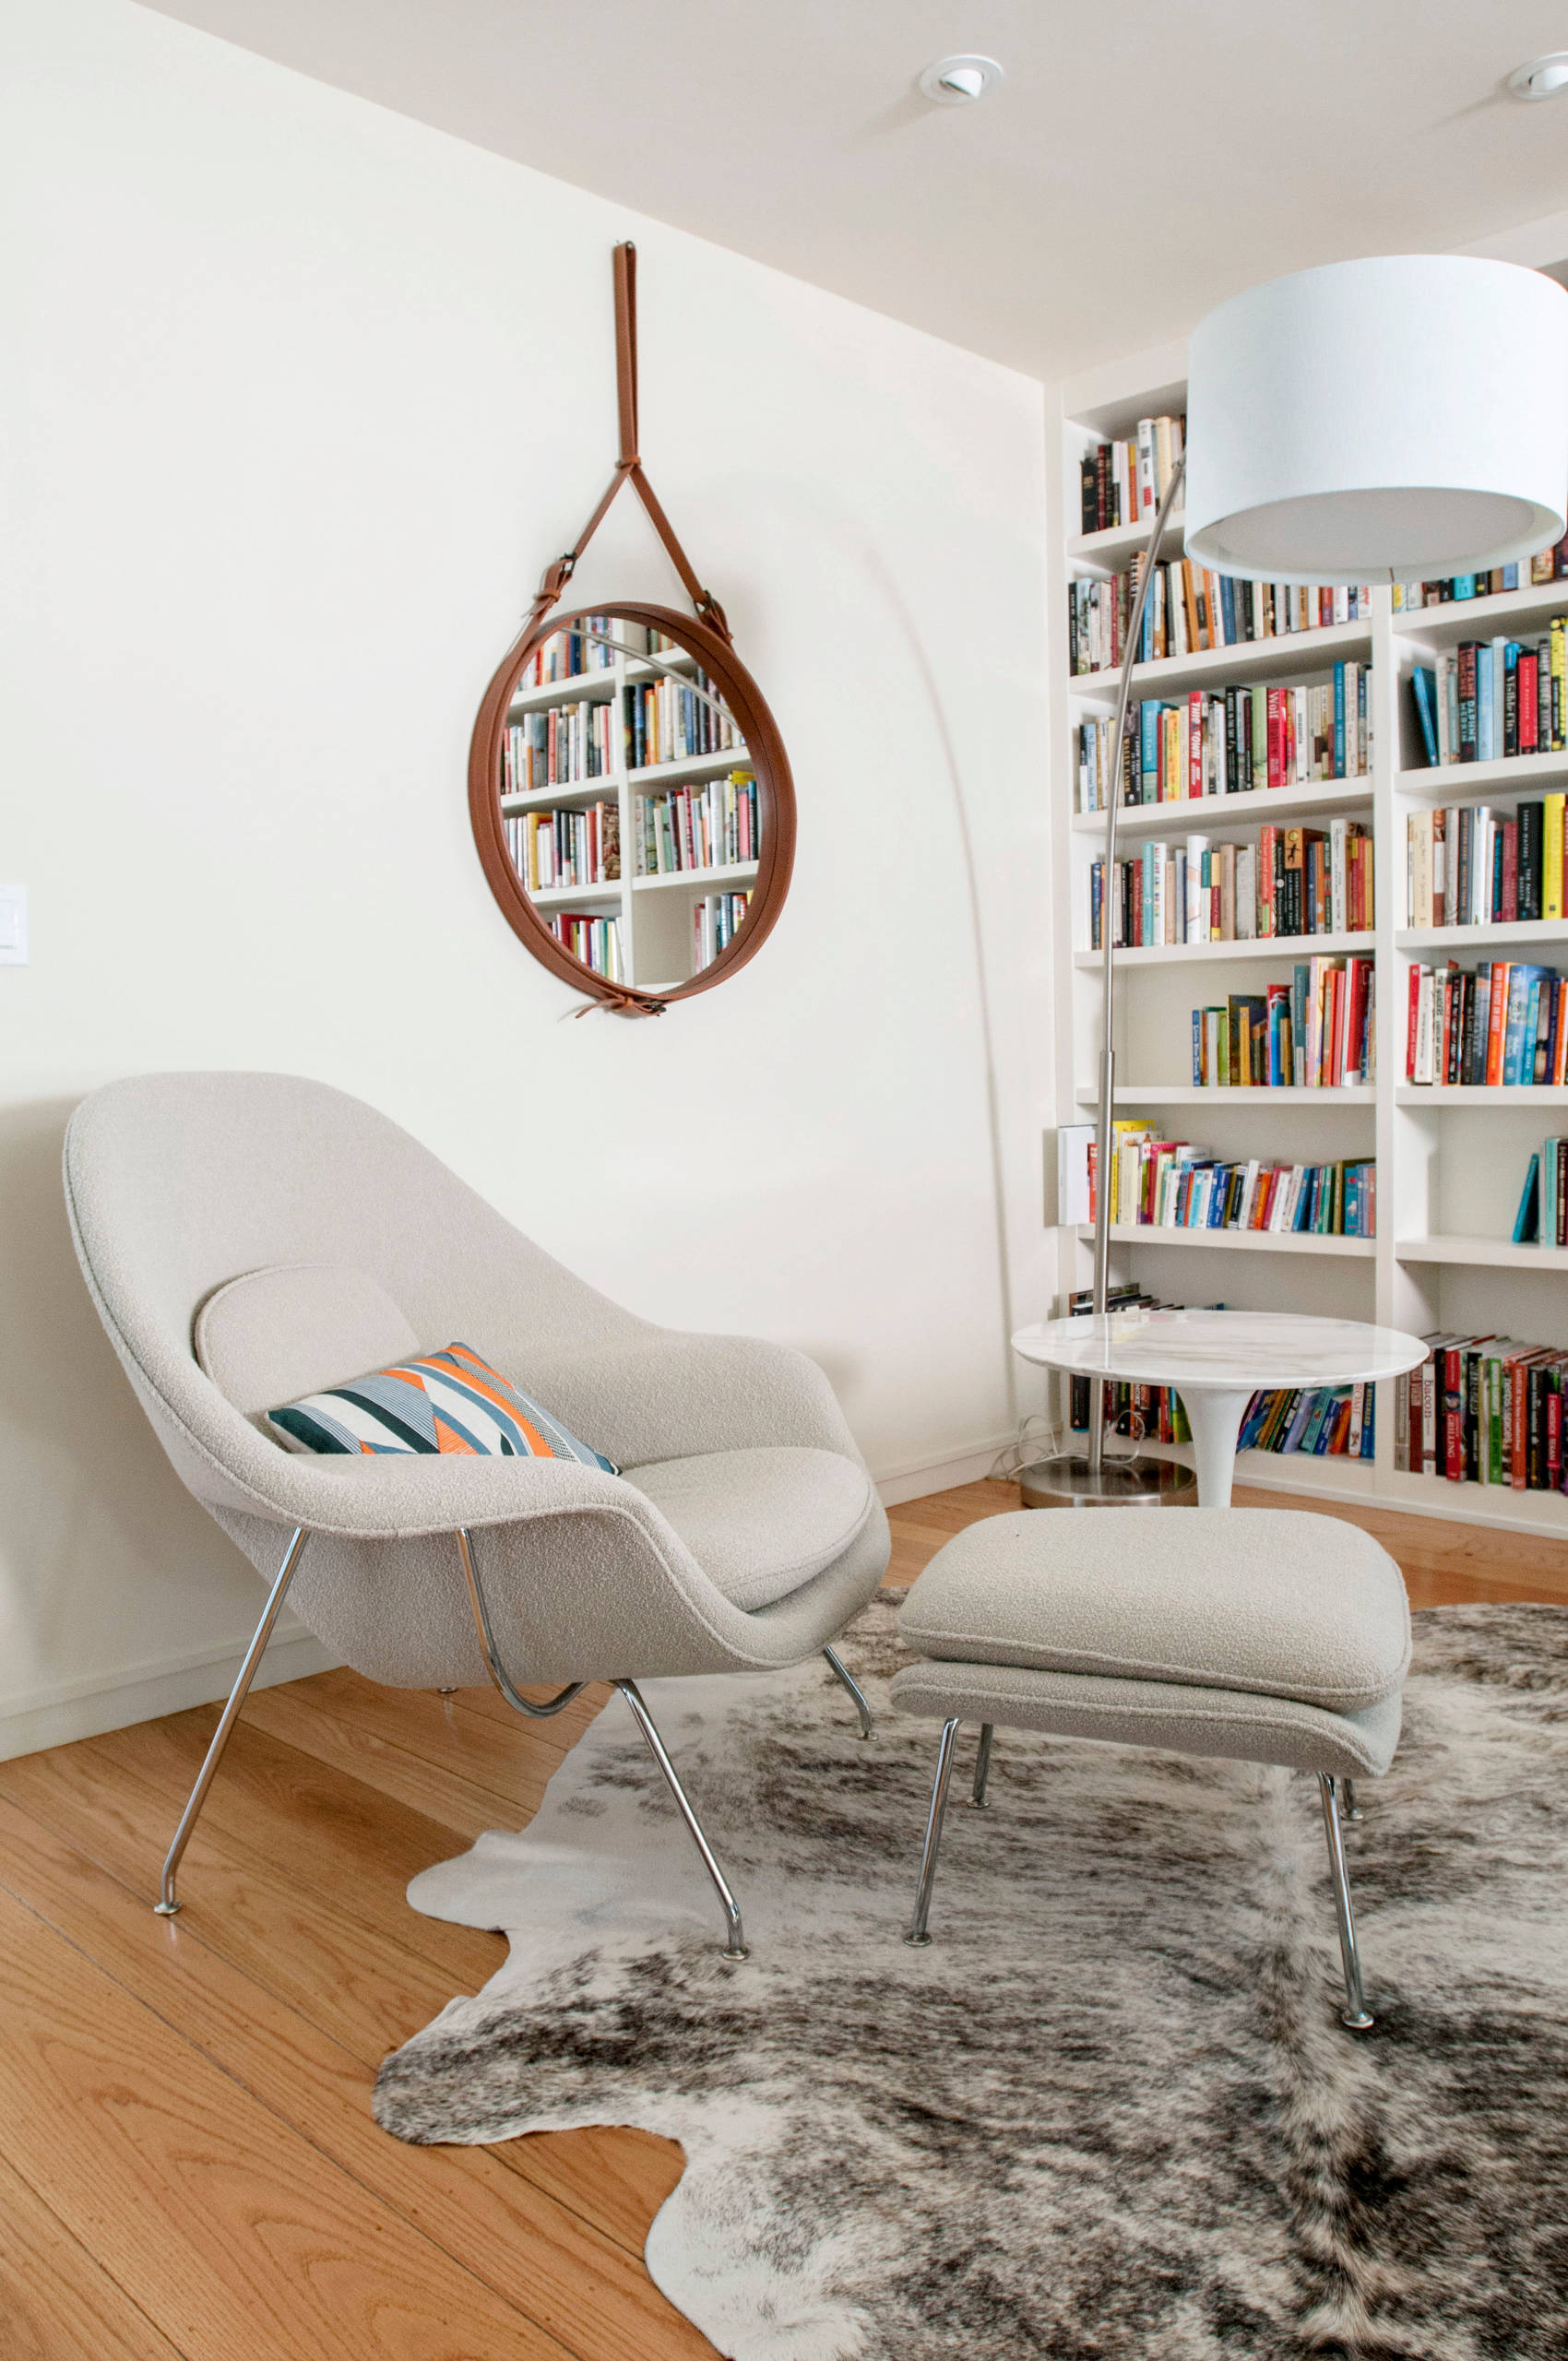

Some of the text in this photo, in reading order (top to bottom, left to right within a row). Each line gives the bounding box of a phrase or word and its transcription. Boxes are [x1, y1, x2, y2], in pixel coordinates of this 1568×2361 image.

[1268, 692, 1278, 719] Wolf
[1506, 675, 1515, 711] Visible
[1192, 702, 1200, 758] THIS TOWN
[1506, 712, 1515, 733] City
[1353, 1383, 1362, 1416] ROME
[1364, 1389, 1372, 1426] REVEALED
[1424, 1380, 1433, 1418] bacon
